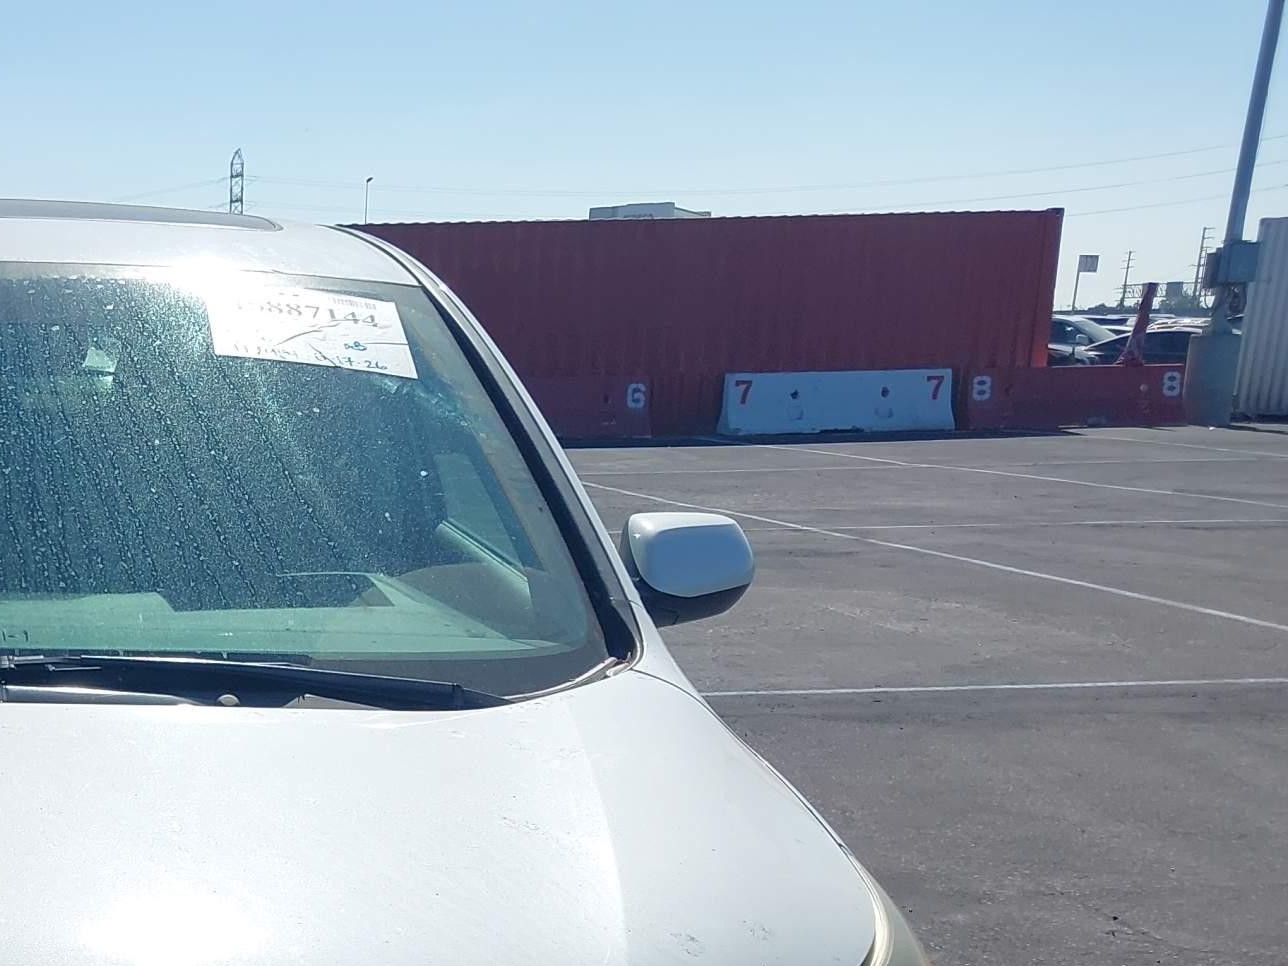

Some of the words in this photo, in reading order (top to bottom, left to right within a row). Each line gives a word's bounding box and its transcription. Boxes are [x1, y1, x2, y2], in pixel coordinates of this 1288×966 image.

[626, 383, 647, 409] 6
[735, 379, 753, 405] 7
[926, 375, 945, 400] 7
[972, 375, 991, 401] 8
[1163, 371, 1181, 397] 8
